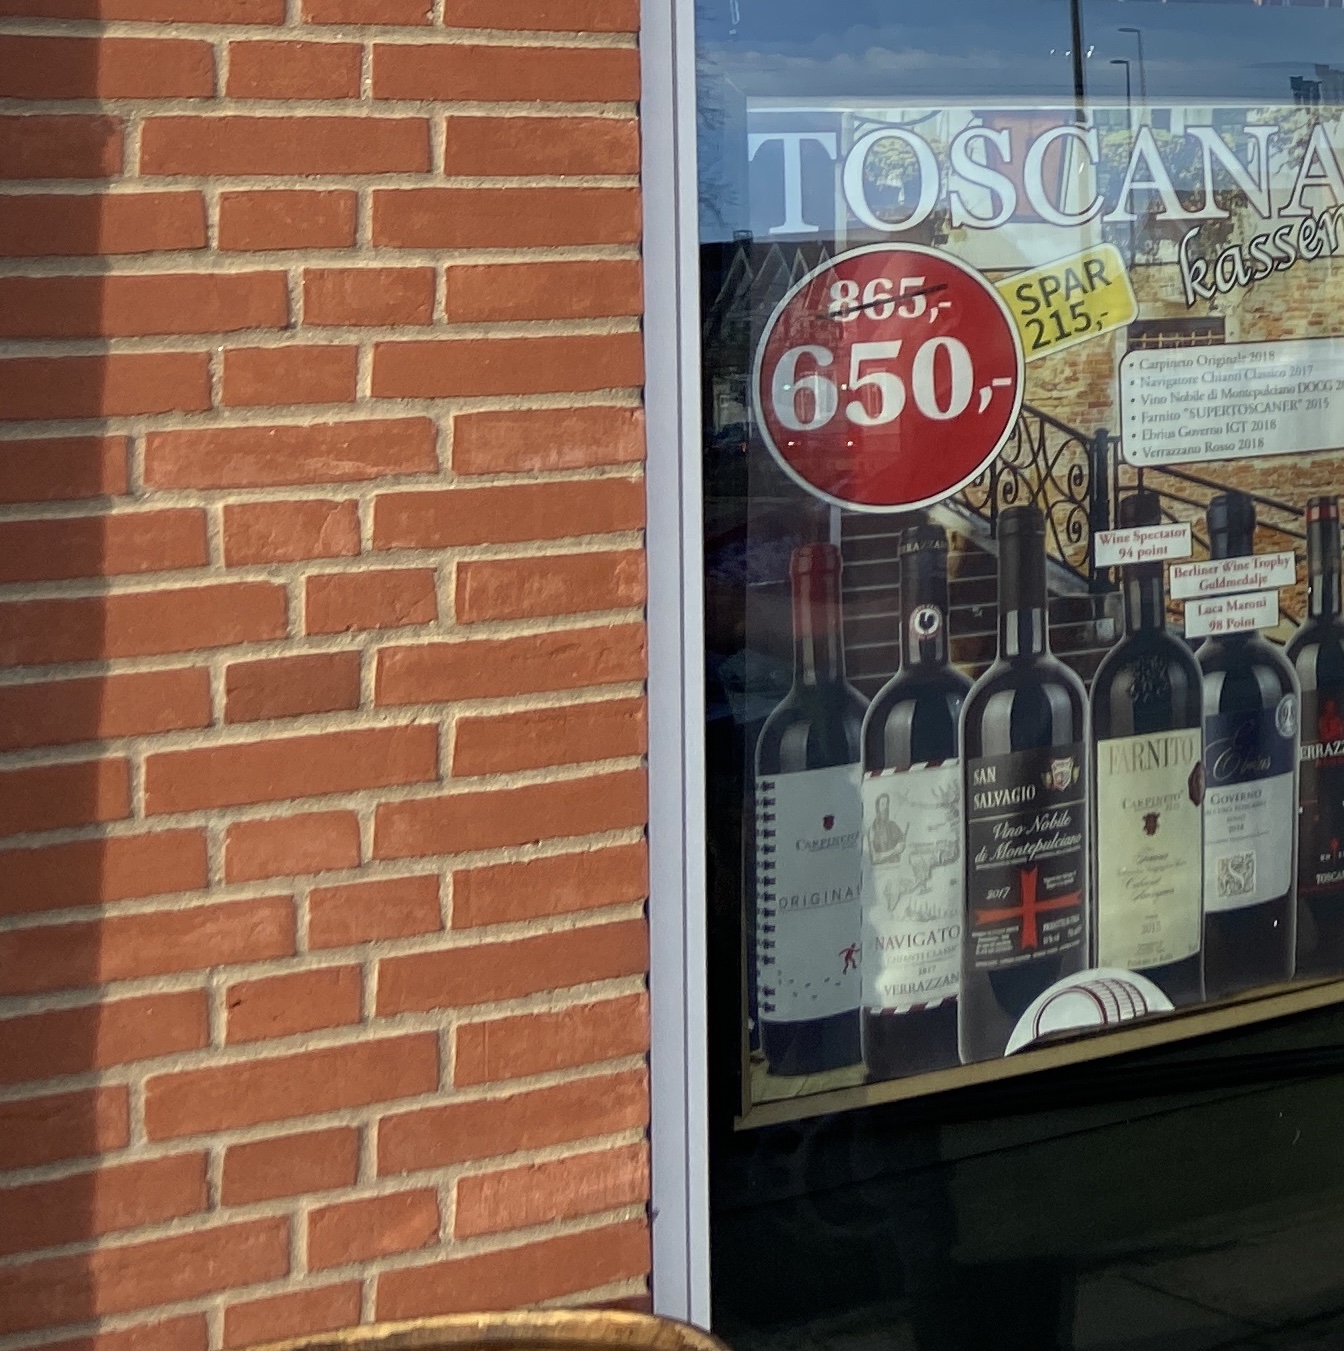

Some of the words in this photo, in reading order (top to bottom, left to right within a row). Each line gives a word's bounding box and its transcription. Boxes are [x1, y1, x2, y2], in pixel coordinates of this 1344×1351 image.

[1015, 257, 1111, 315] SPAR
[771, 336, 1012, 431] 650,-
[1099, 532, 1131, 546] Wine
[1132, 527, 1188, 545] Spectator
[1136, 545, 1169, 560] point
[1173, 564, 1219, 579] Berliner
[1251, 554, 1291, 570] Trophy
[973, 766, 997, 786] SAN
[974, 784, 1037, 810] SALVAGIO
